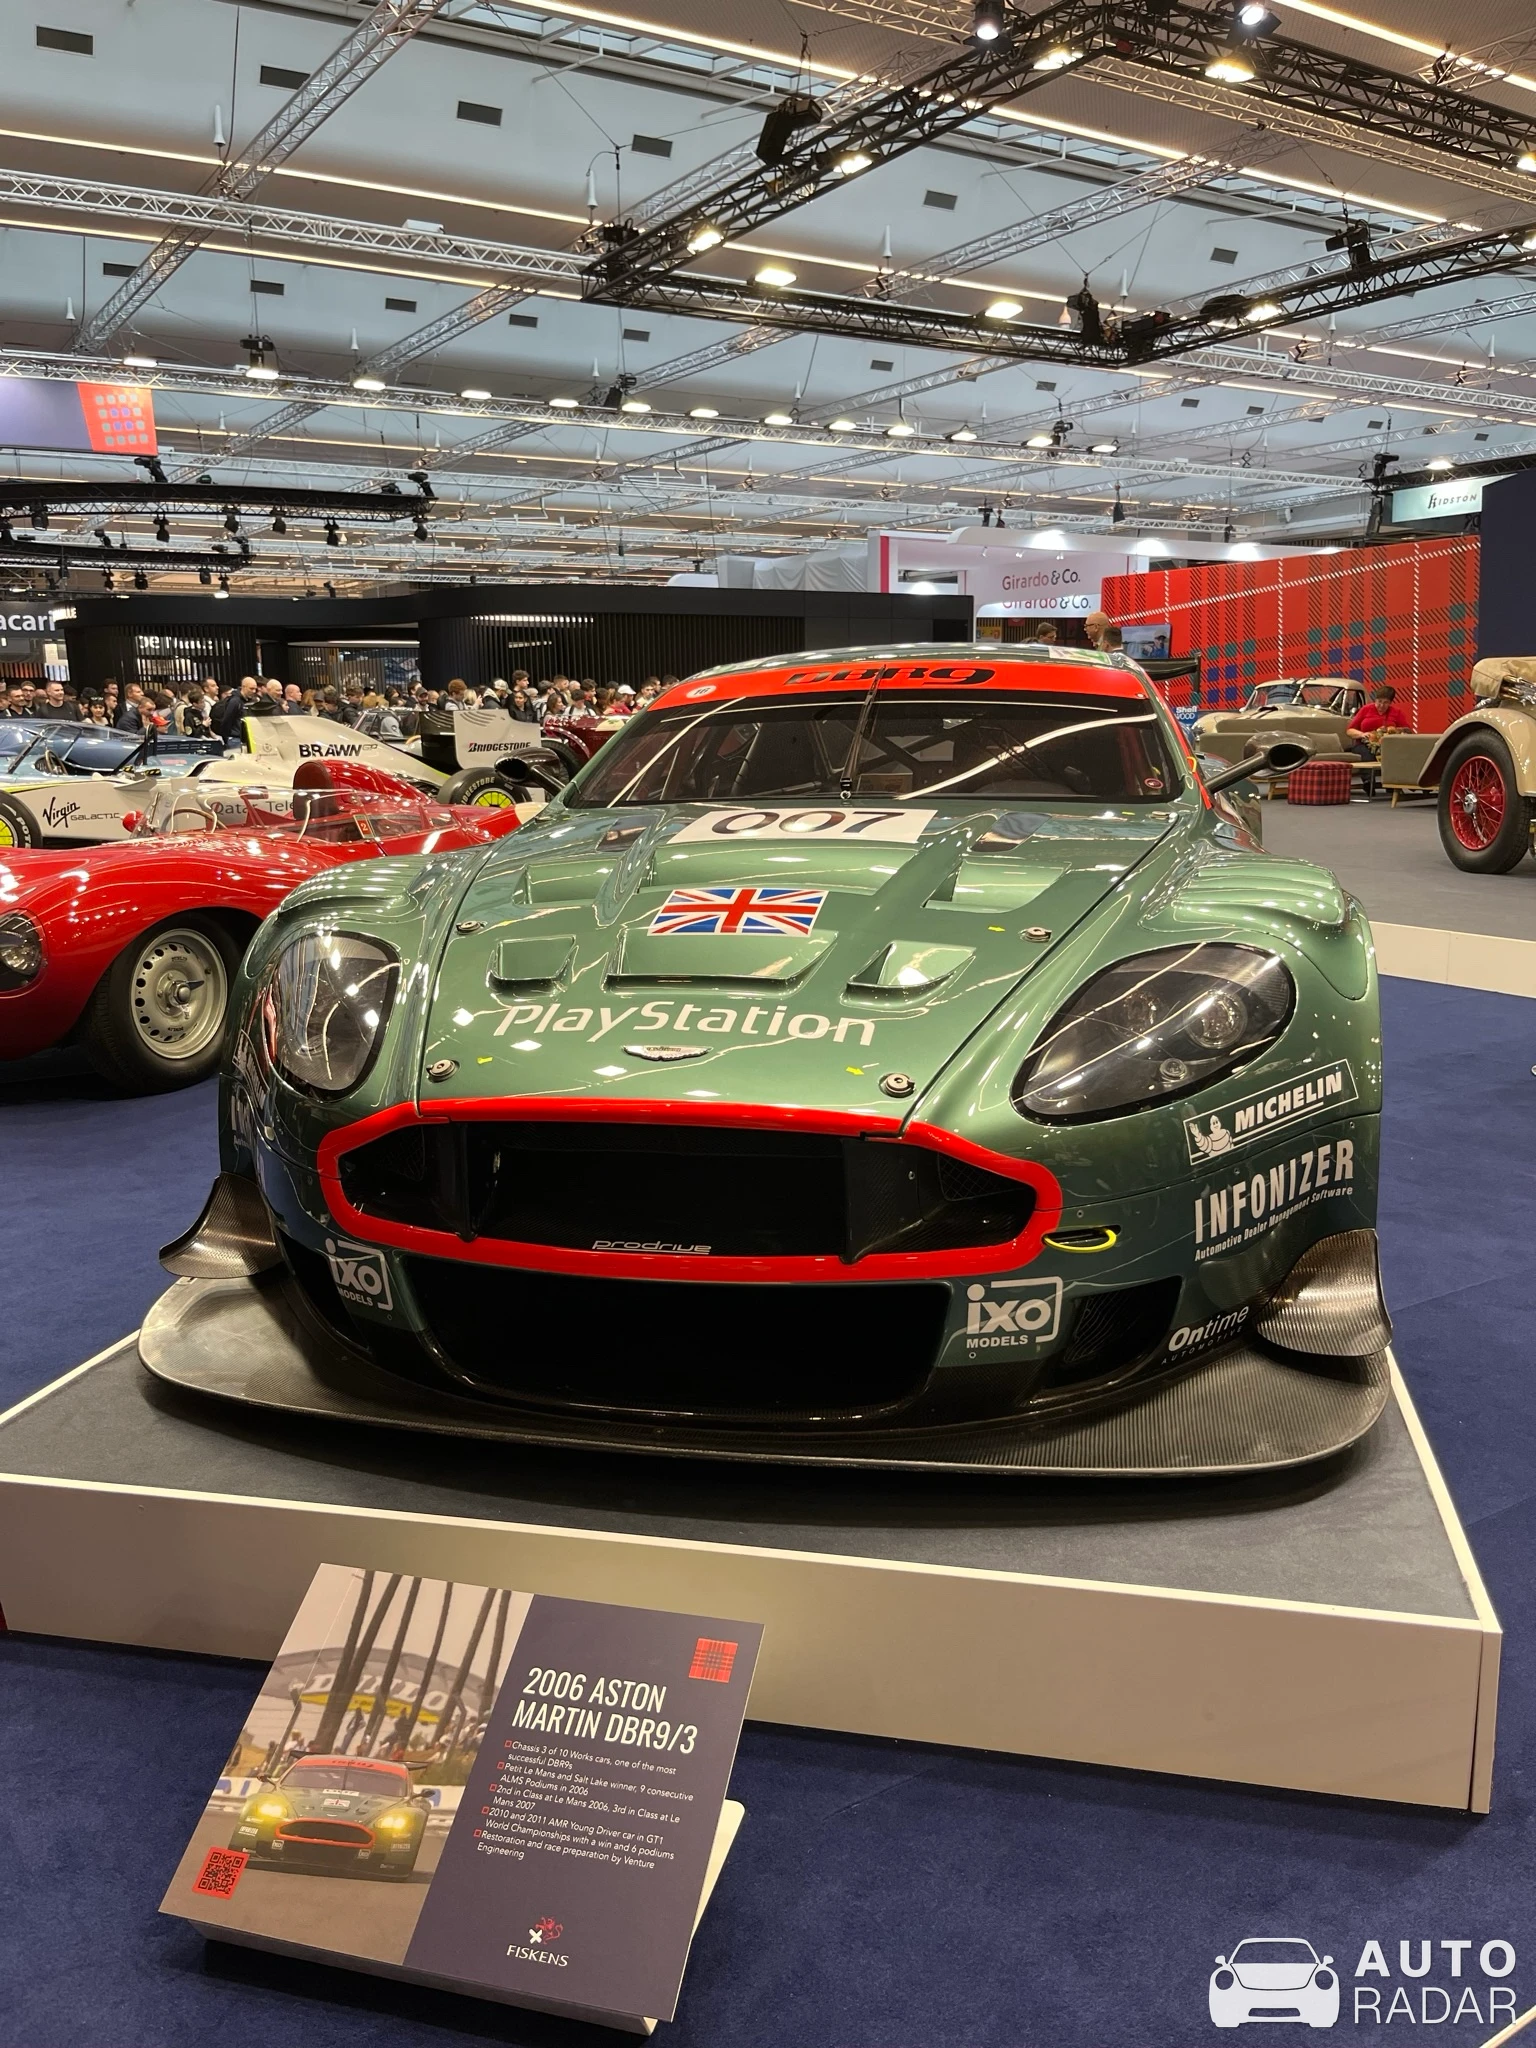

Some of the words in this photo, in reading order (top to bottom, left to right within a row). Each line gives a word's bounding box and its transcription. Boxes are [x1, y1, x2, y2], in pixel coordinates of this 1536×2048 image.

[1428, 493, 1477, 509] KIDSTON
[1002, 572, 1049, 591] Girardo
[1051, 570, 1060, 586] &
[1062, 569, 1081, 584] Co.
[783, 667, 996, 686] DBR9
[1176, 705, 1198, 713] Shell
[299, 743, 362, 758] BRAWN
[468, 741, 531, 753] BRIDGESTONE
[42, 797, 80, 828] Virgin
[712, 810, 905, 834] 007
[493, 1001, 876, 1046] PlayStation
[1235, 1071, 1342, 1133] MICHELIN
[1194, 1139, 1354, 1244] INFONIZER
[1195, 1234, 1242, 1261] Automotive
[1243, 1220, 1268, 1240] Dealer
[1268, 1197, 1310, 1227] Management
[1311, 1186, 1353, 1203] Software
[592, 1240, 712, 1254] prodrive
[337, 1286, 374, 1306] MODELS
[966, 1334, 1029, 1349] MODELS
[1168, 1305, 1249, 1352] Ontime
[1161, 1325, 1243, 1364] AUTOMOTIVE
[523, 1667, 587, 1701] 2006
[588, 1677, 667, 1713] ASTON
[511, 1700, 602, 1739] MARTIN
[604, 1713, 698, 1754] DBR9/3
[508, 1753, 546, 1764] successful
[547, 1758, 573, 1770] DBR9s
[512, 1741, 540, 1753] Chassis
[541, 1746, 547, 1754] 3
[559, 1749, 568, 1757] 10
[570, 1750, 593, 1762] Works
[595, 1756, 612, 1765] cars,
[632, 1760, 640, 1769] of
[642, 1762, 654, 1771] the
[656, 1766, 676, 1775] most
[500, 1774, 524, 1785] ALMS
[525, 1778, 558, 1792] Podiums
[560, 1784, 567, 1792] in
[569, 1785, 588, 1796] 2006
[504, 1763, 522, 1773] Petit
[524, 1766, 533, 1774] Le
[535, 1768, 555, 1779] Mans
[557, 1771, 572, 1780] and
[574, 1774, 589, 1784] Salt
[590, 1777, 608, 1787] Lake
[610, 1782, 637, 1793] winner,
[647, 1788, 694, 1801] consecutive
[493, 1796, 514, 1807] Mans
[515, 1800, 536, 1810] 2007
[497, 1785, 512, 1795] 2nd
[514, 1787, 520, 1796] in
[523, 1789, 542, 1800] Class
[555, 1795, 564, 1804] Le
[566, 1796, 587, 1807] Mans
[588, 1800, 610, 1812] 2006,
[612, 1804, 626, 1814] 3rd
[628, 1807, 635, 1815] in
[637, 1809, 658, 1820] Class
[660, 1814, 668, 1822] at
[670, 1814, 680, 1823] Le
[486, 1819, 509, 1831] World
[511, 1823, 570, 1843] Championships
[573, 1836, 589, 1845] with
[598, 1840, 611, 1848] win
[614, 1843, 629, 1852] and
[631, 1845, 636, 1853] 6
[638, 1846, 674, 1860] podiums
[489, 1808, 509, 1818] 2010
[510, 1812, 525, 1820] and
[527, 1814, 546, 1824] 2011
[548, 1818, 568, 1828] AMR
[570, 1822, 594, 1835] Young
[596, 1826, 621, 1837] Driver
[623, 1832, 635, 1840] car
[637, 1833, 644, 1841] in
[646, 1834, 664, 1845] GT1
[477, 1842, 525, 1860] Engineering
[481, 1830, 525, 1846] Restoration
[527, 1840, 543, 1849] and
[544, 1844, 561, 1852] race
[562, 1846, 609, 1860] preparation
[611, 1853, 621, 1865] by
[624, 1856, 655, 1869] Venture
[506, 1944, 569, 1967] FISKENS
